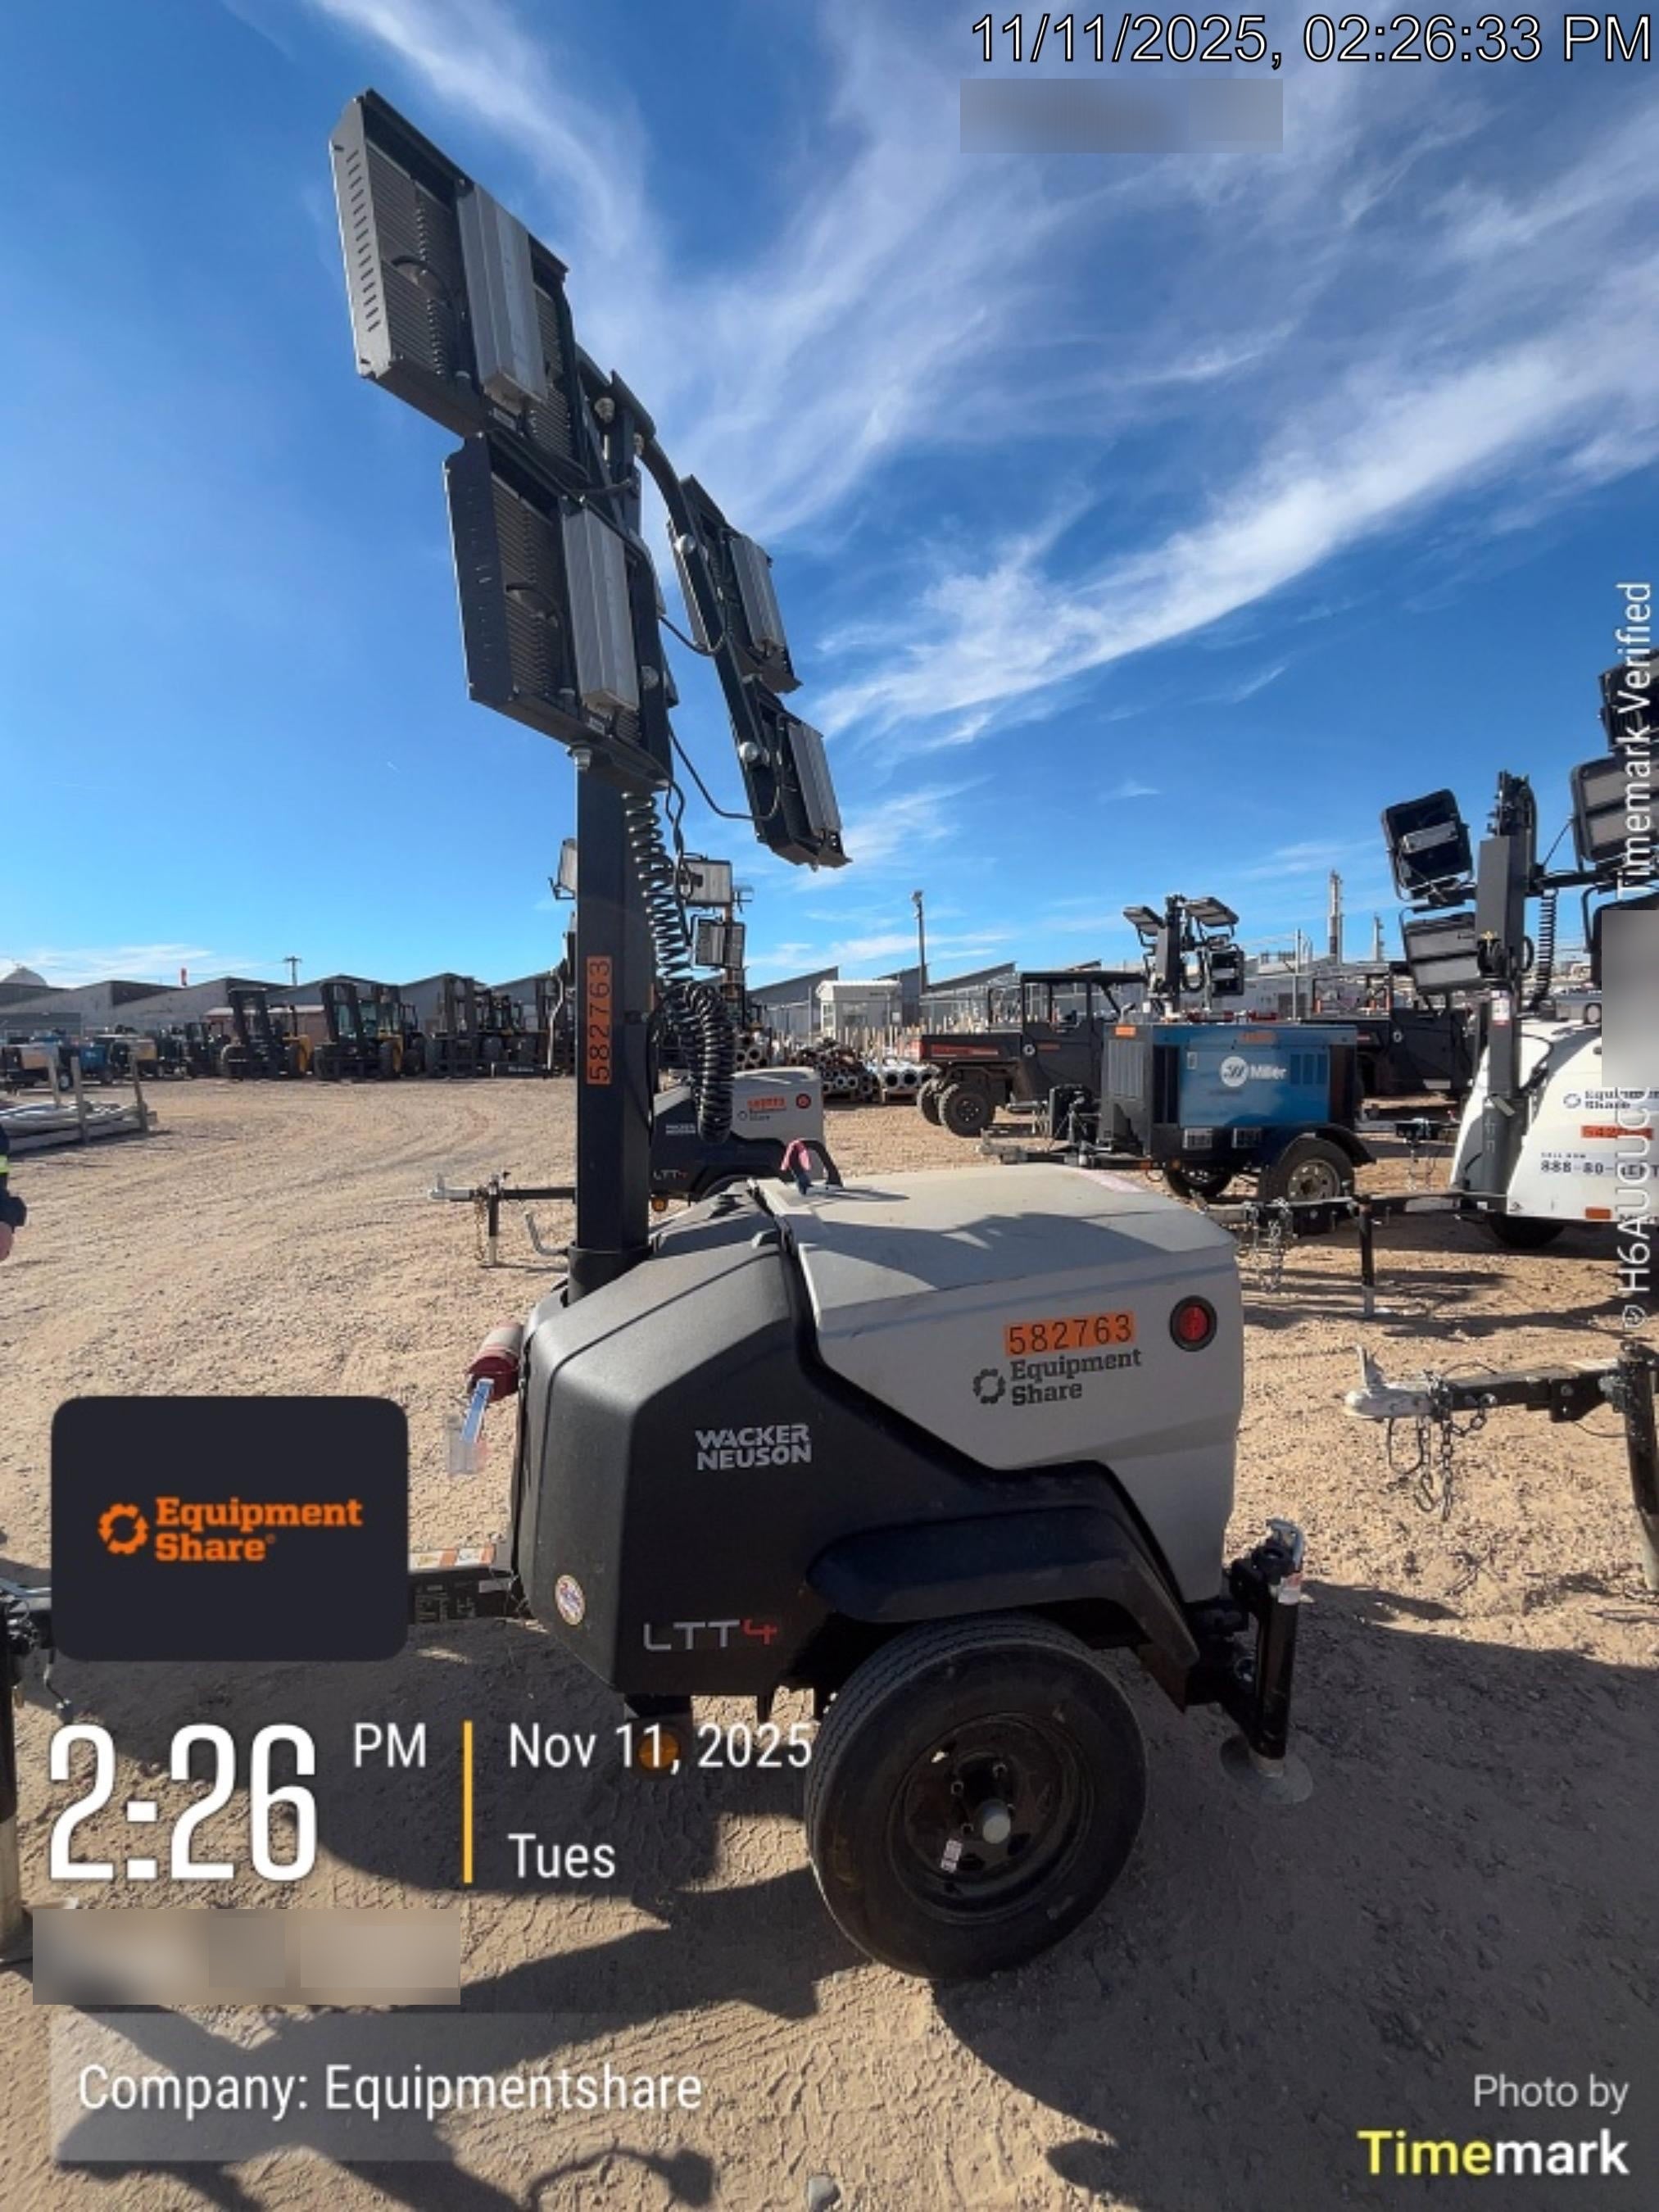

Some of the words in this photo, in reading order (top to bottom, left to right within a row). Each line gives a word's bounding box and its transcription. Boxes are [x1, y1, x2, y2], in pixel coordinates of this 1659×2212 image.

[587, 959, 610, 1081] 582763
[1009, 1314, 1131, 1354] 582763
[1010, 1349, 1141, 1383] Equipment
[1012, 1382, 1083, 1407] Share
[695, 1423, 810, 1449] WACKER
[696, 1444, 812, 1471] NEUSON
[643, 1619, 777, 1651] LTT4
